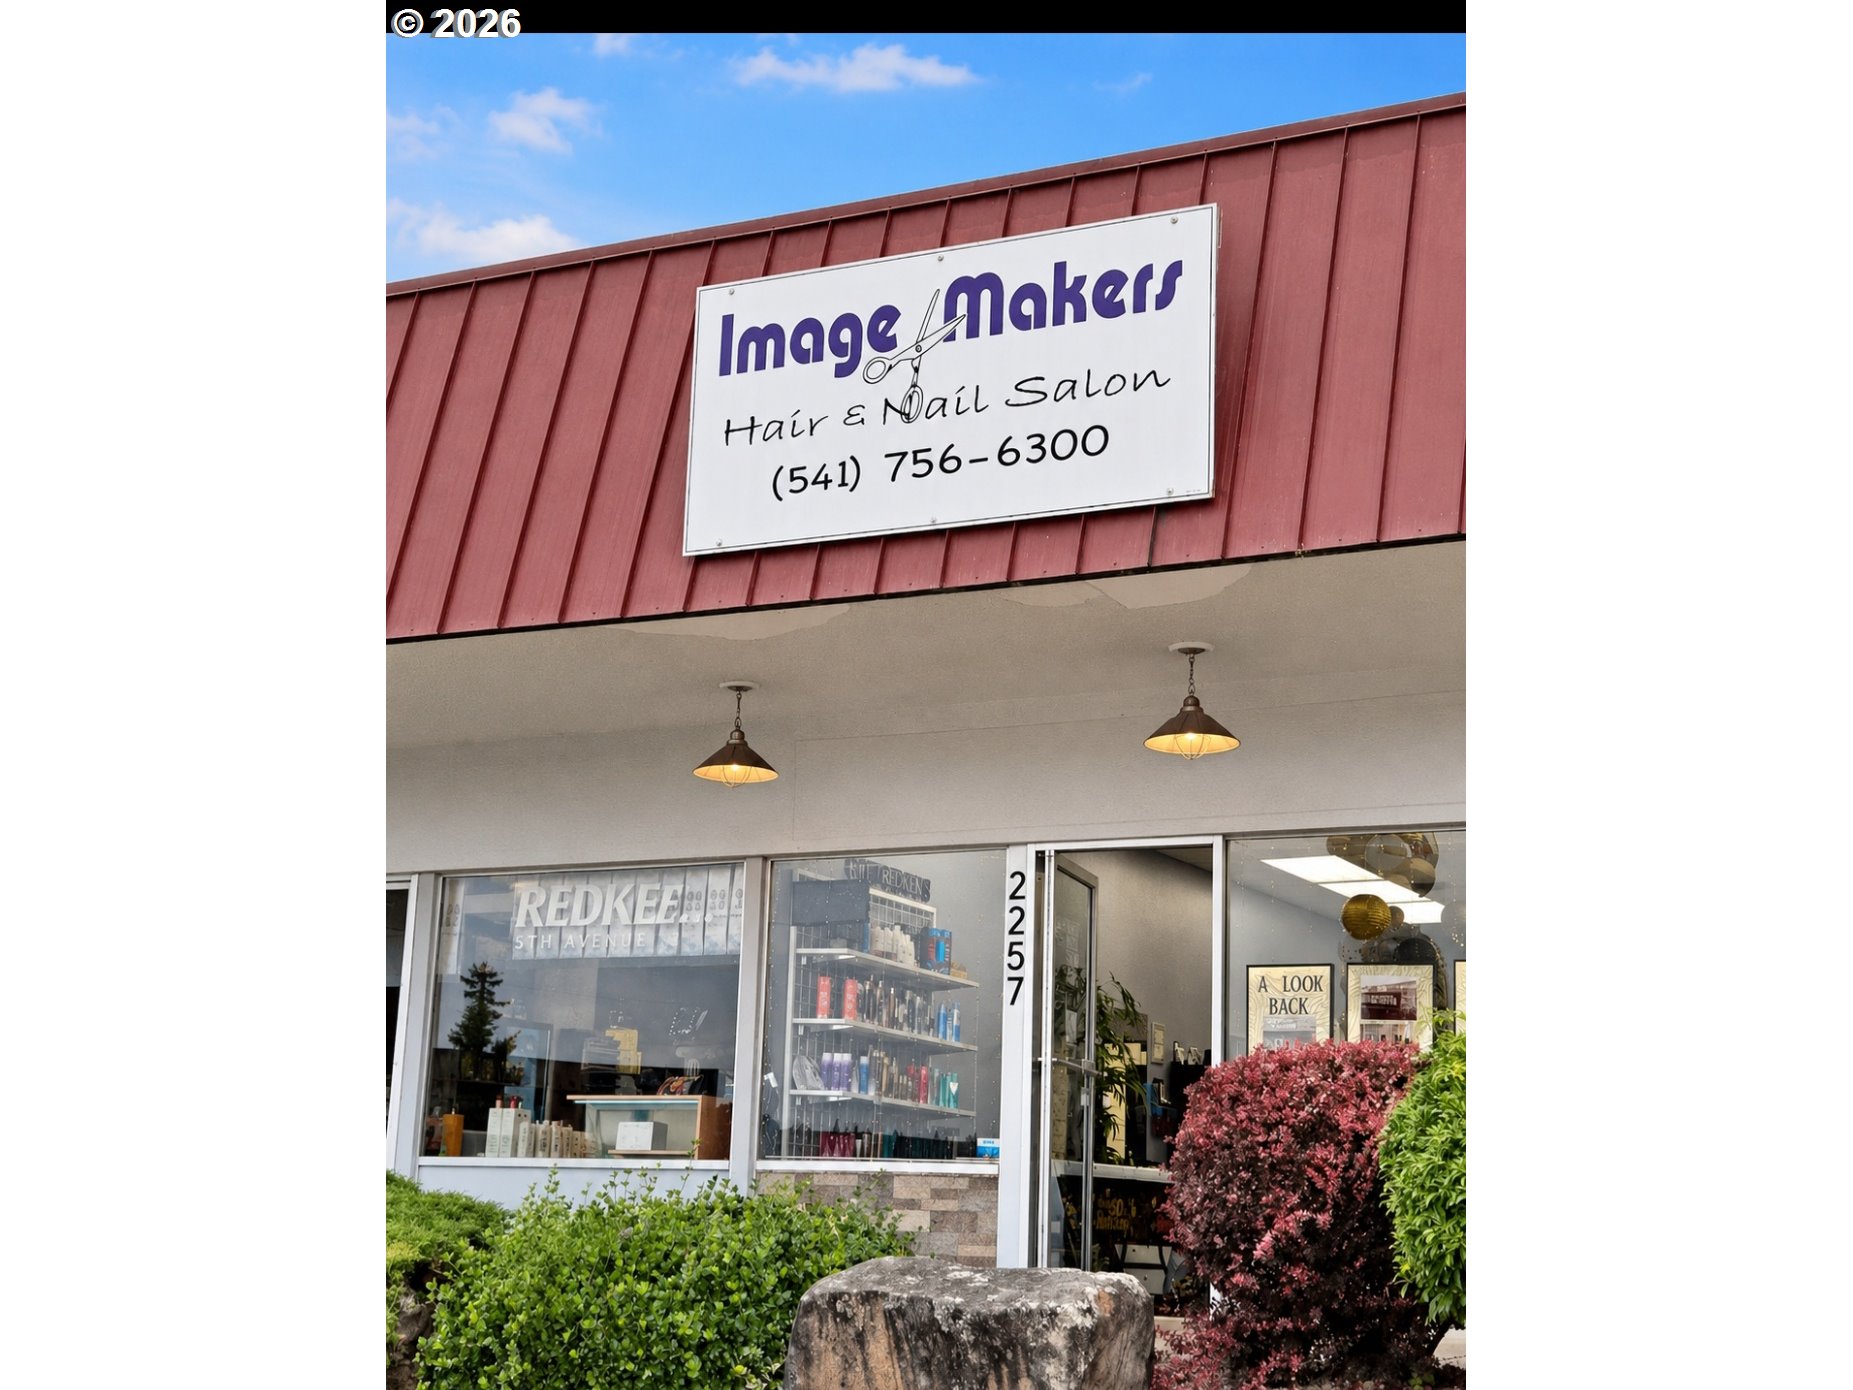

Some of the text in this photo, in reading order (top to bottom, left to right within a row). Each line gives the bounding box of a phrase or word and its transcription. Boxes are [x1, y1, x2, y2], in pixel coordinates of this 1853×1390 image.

[718, 260, 1184, 378] Image Makers
[724, 368, 1172, 447] Hair & Nail Salon
[772, 424, 1110, 502] (541) 756-6300
[515, 932, 646, 951] 5TH AVENUE
[1007, 870, 1026, 1006] 2257
[1257, 974, 1324, 993] A LOOK
[1268, 997, 1309, 1016] BACK
